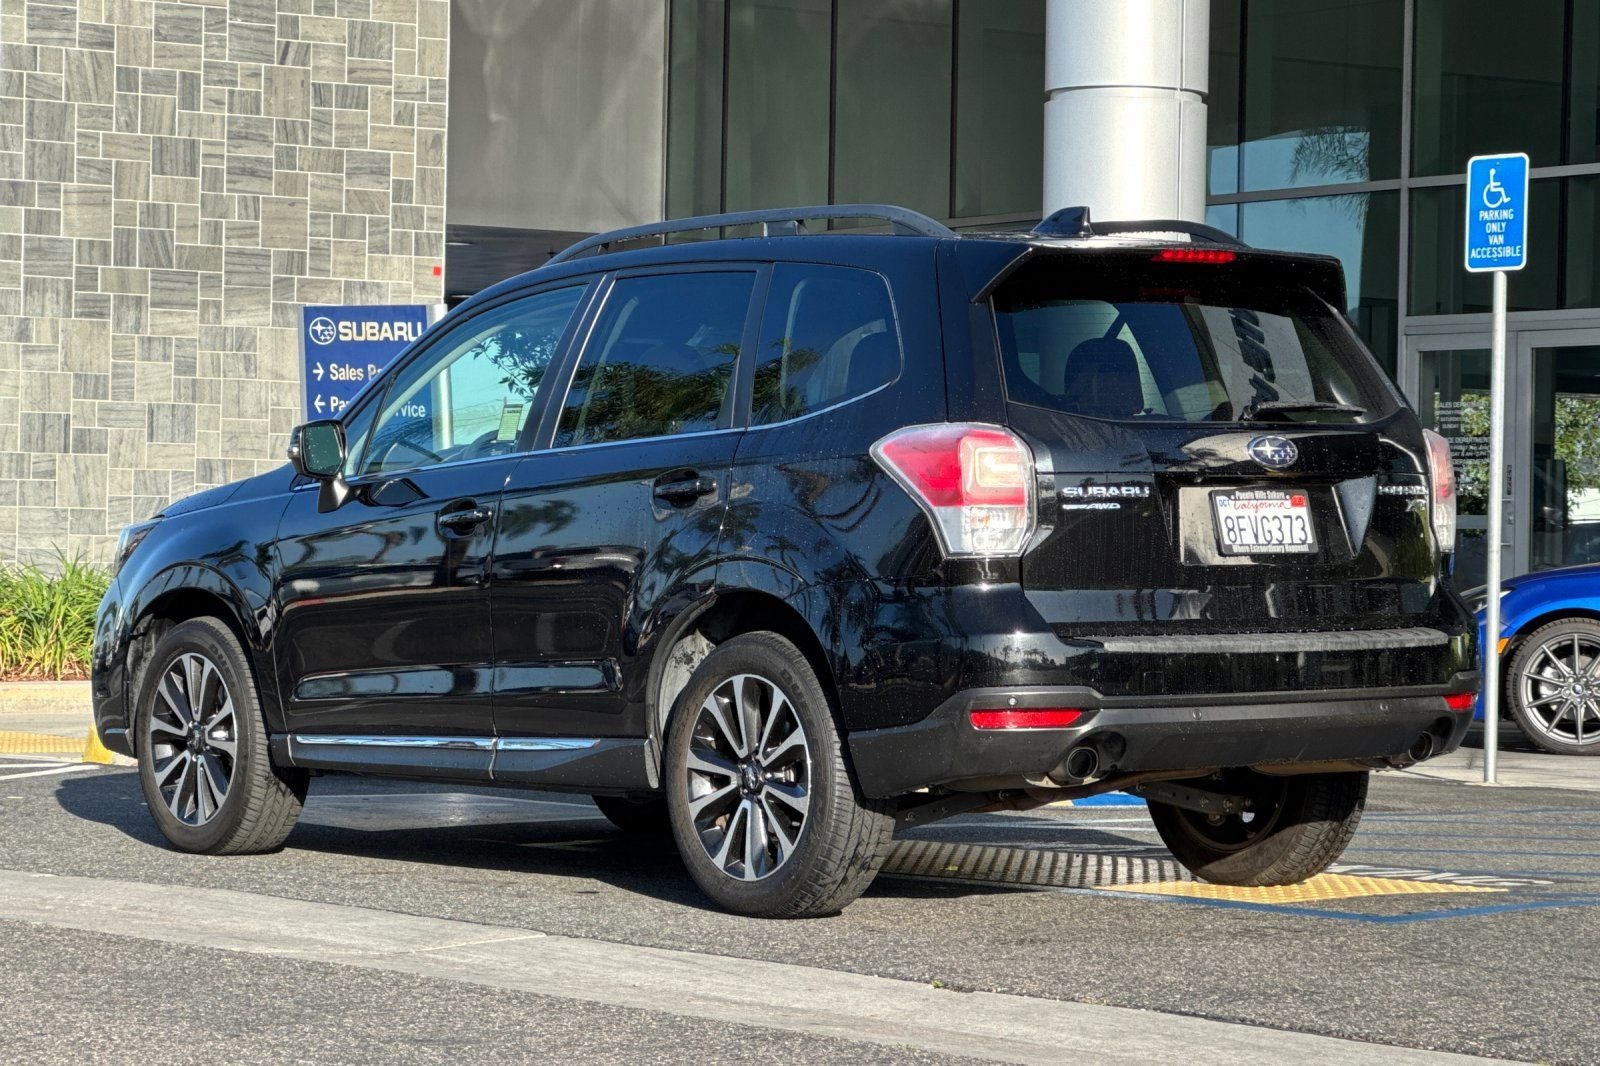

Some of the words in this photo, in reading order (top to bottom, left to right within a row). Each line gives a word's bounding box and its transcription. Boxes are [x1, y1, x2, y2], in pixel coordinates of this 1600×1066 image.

[1479, 209, 1514, 221] PARKING
[1485, 222, 1507, 233] ONLY
[1488, 234, 1504, 245] VAN
[1470, 246, 1521, 259] ACCESSIBLE
[338, 321, 422, 342] SUBARU
[329, 363, 364, 381] Sales
[1062, 486, 1150, 498] SUBARU
[1224, 515, 1308, 545] 8FVG373
